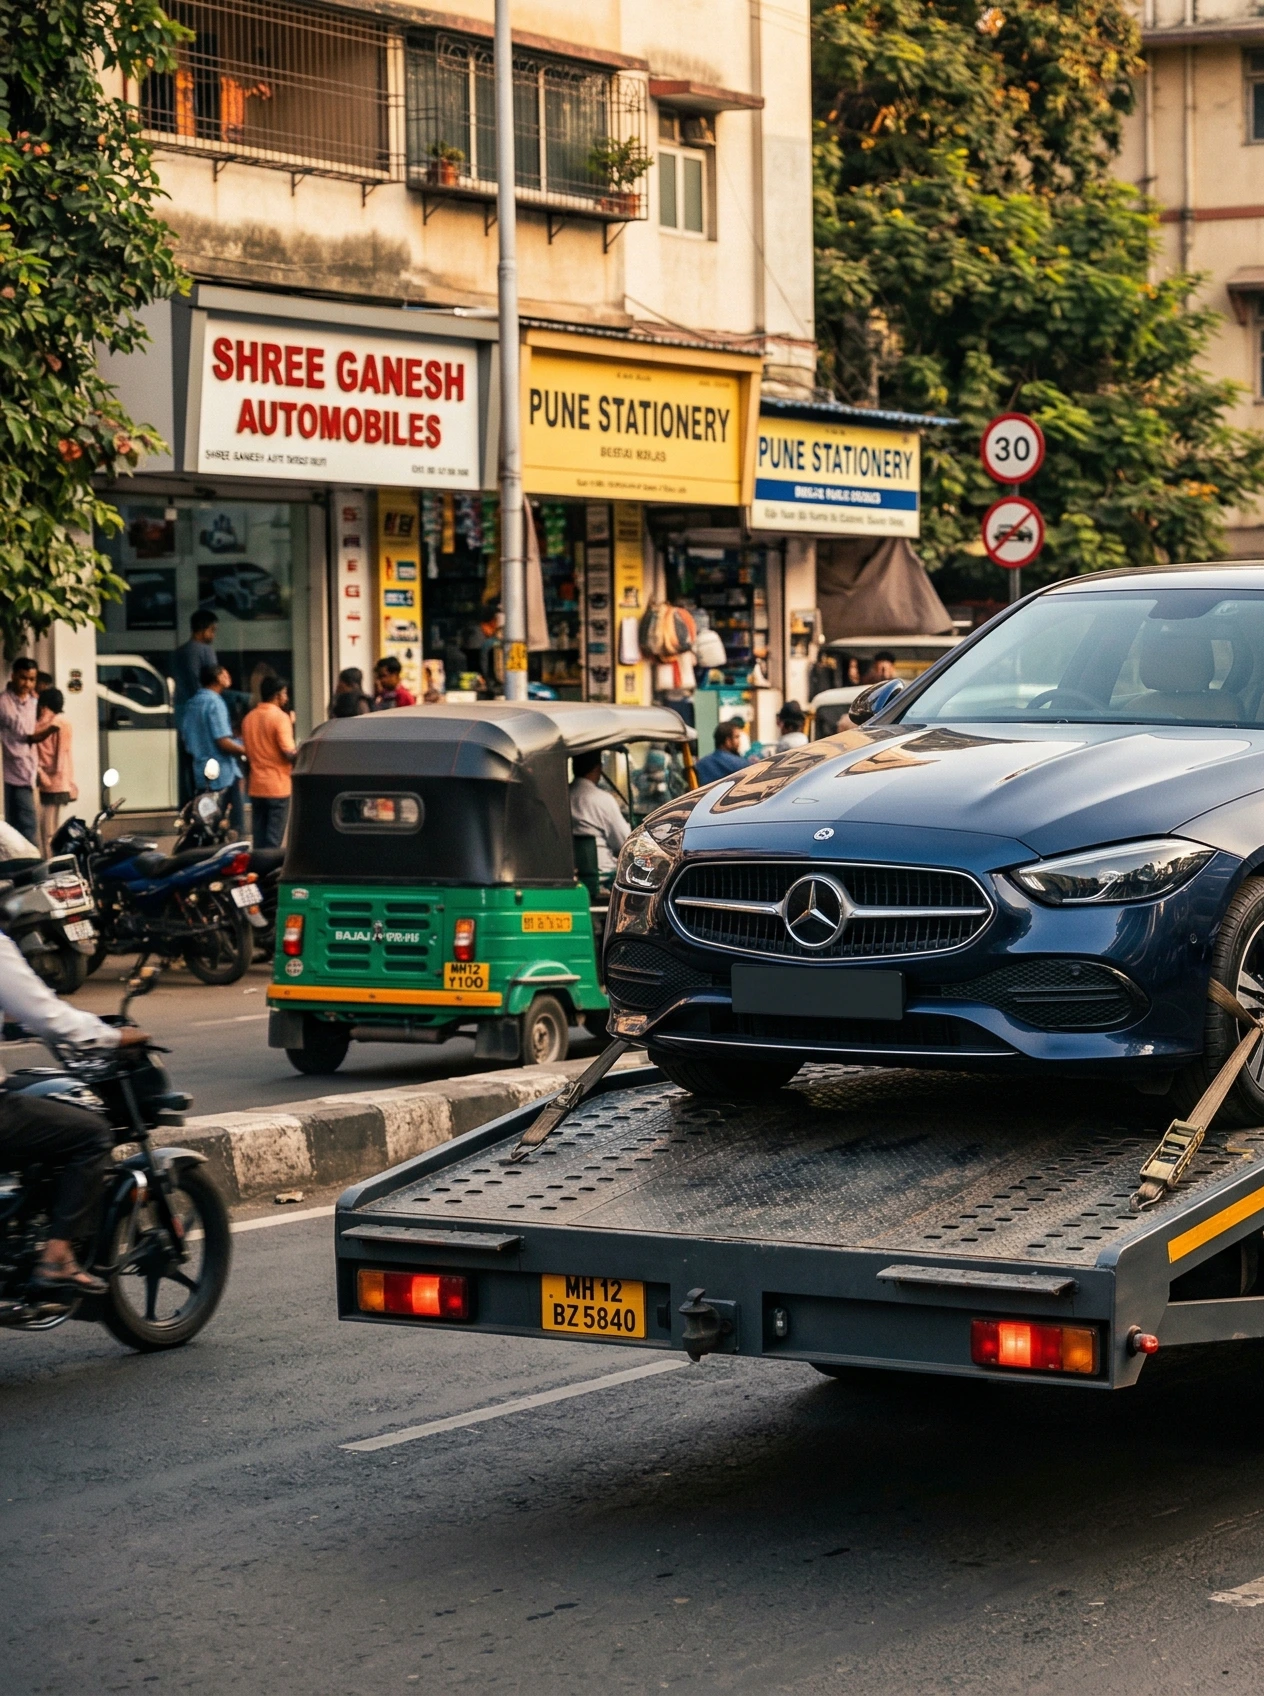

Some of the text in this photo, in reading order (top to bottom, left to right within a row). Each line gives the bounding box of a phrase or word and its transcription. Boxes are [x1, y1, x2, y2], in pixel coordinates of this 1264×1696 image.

[211, 336, 466, 402] SHREE GANESH
[235, 397, 442, 450] AUTOMOBILES
[529, 387, 731, 443] PUNE STATIONERY
[758, 436, 914, 480] PUNE STATIONERY
[994, 436, 1031, 462] 30
[335, 930, 371, 942] BAJAJ
[448, 976, 484, 989] Y100
[450, 963, 481, 975] MH12
[565, 1276, 623, 1303] MH 12
[553, 1302, 636, 1333] BZ 5840
